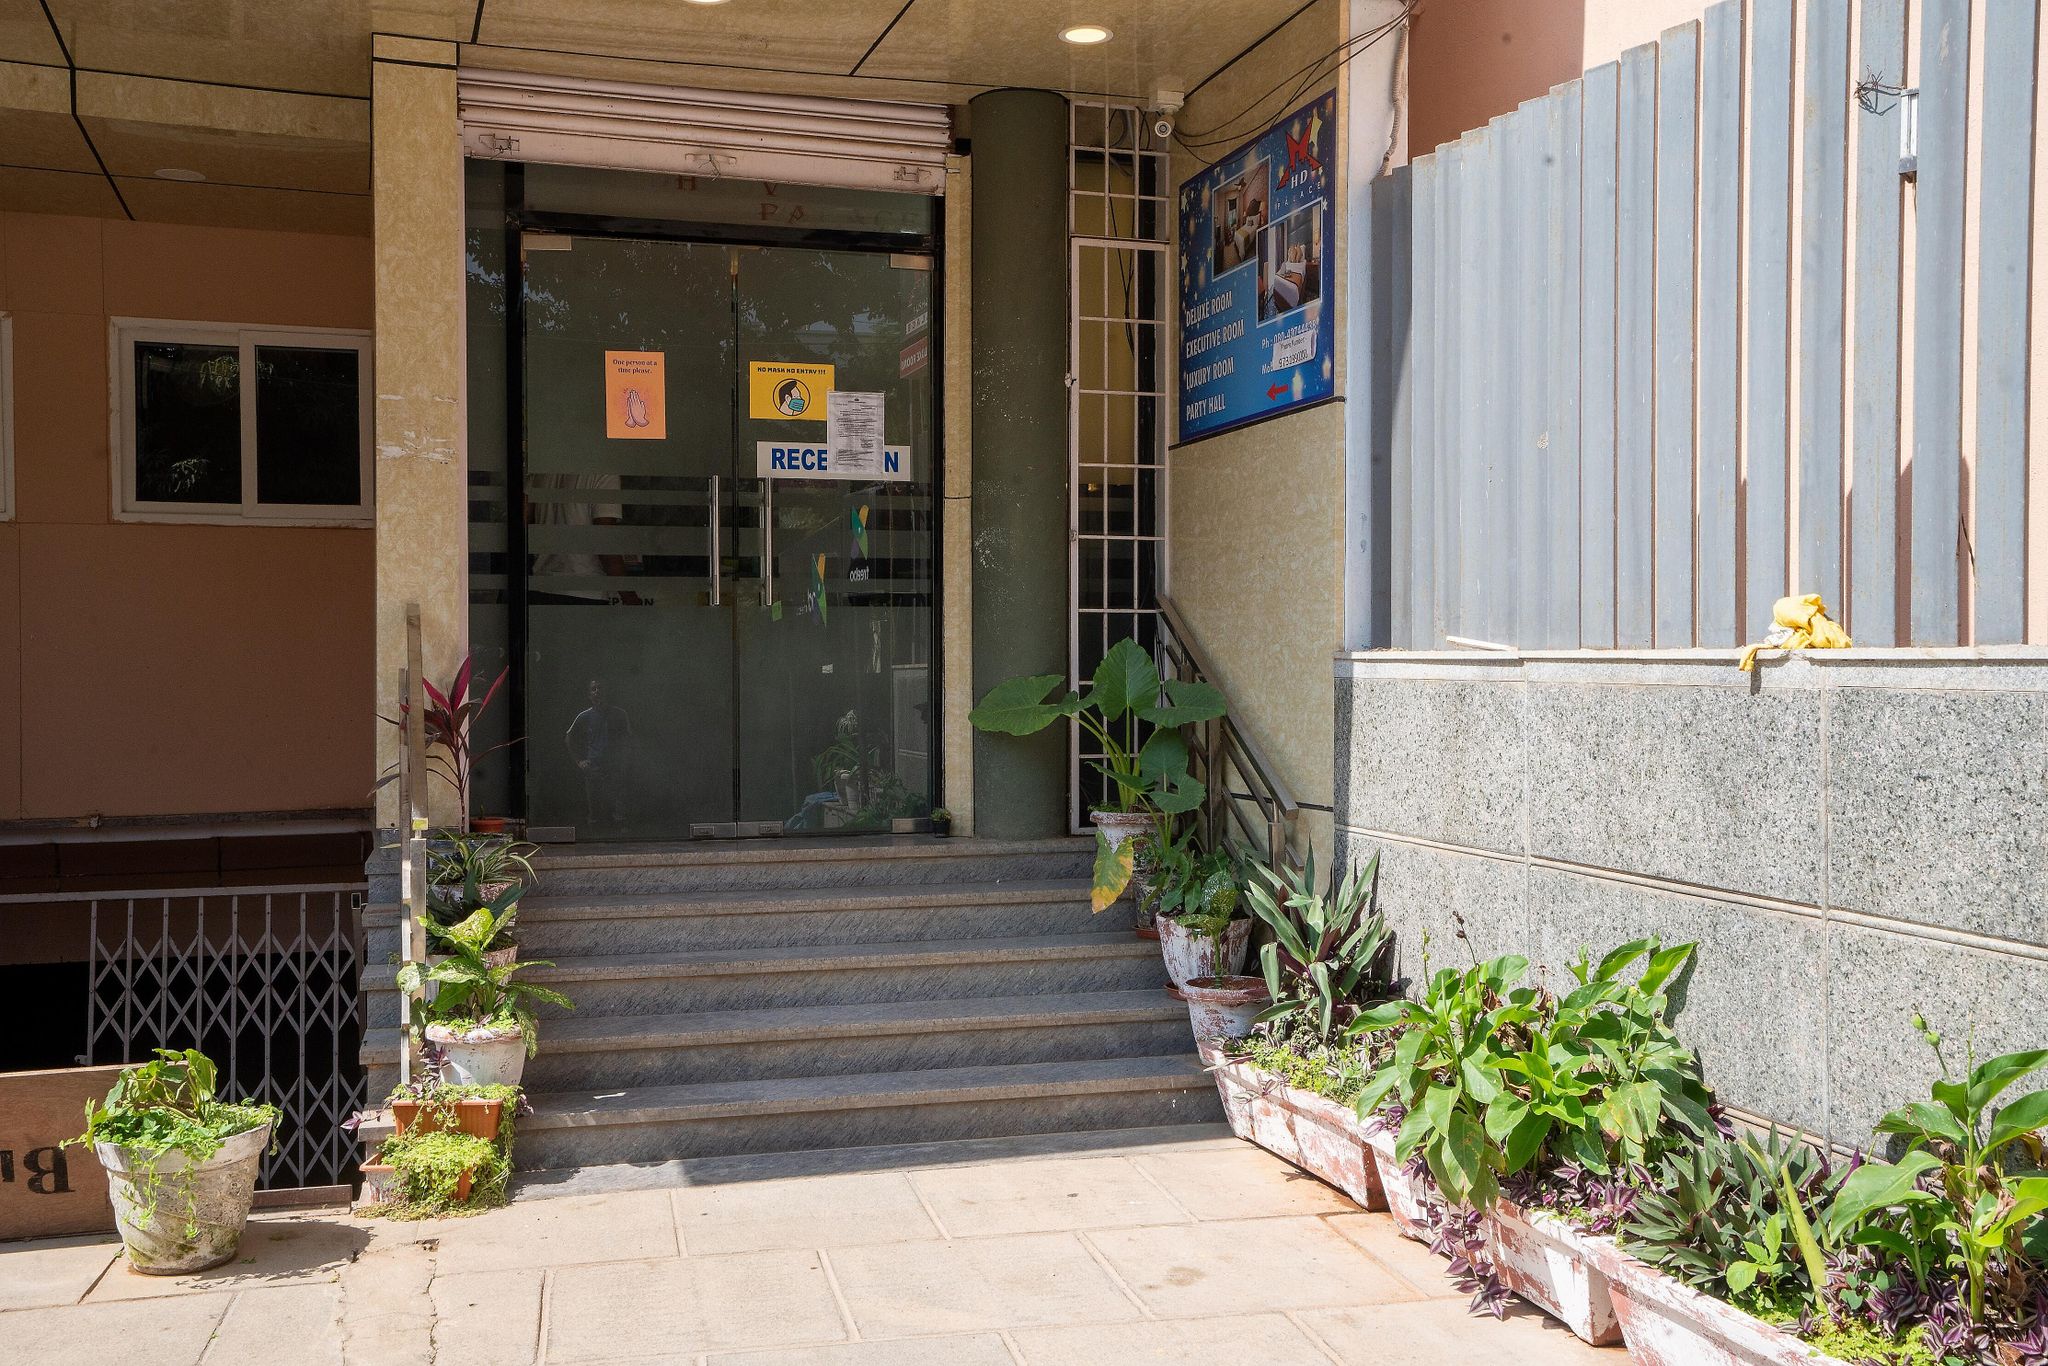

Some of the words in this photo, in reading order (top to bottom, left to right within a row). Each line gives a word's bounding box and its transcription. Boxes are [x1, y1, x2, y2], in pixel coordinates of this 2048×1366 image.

[1186, 298, 1210, 328] DELUXE
[1211, 290, 1233, 315] ROOM
[1186, 330, 1222, 359] EXECUTIVE
[1222, 318, 1245, 344] ROOM
[1186, 366, 1211, 391] LUXURY
[1212, 357, 1234, 381] ROOM
[1186, 397, 1208, 422] PARTY
[1208, 393, 1226, 414] HALL
[771, 447, 899, 473] RECEN
